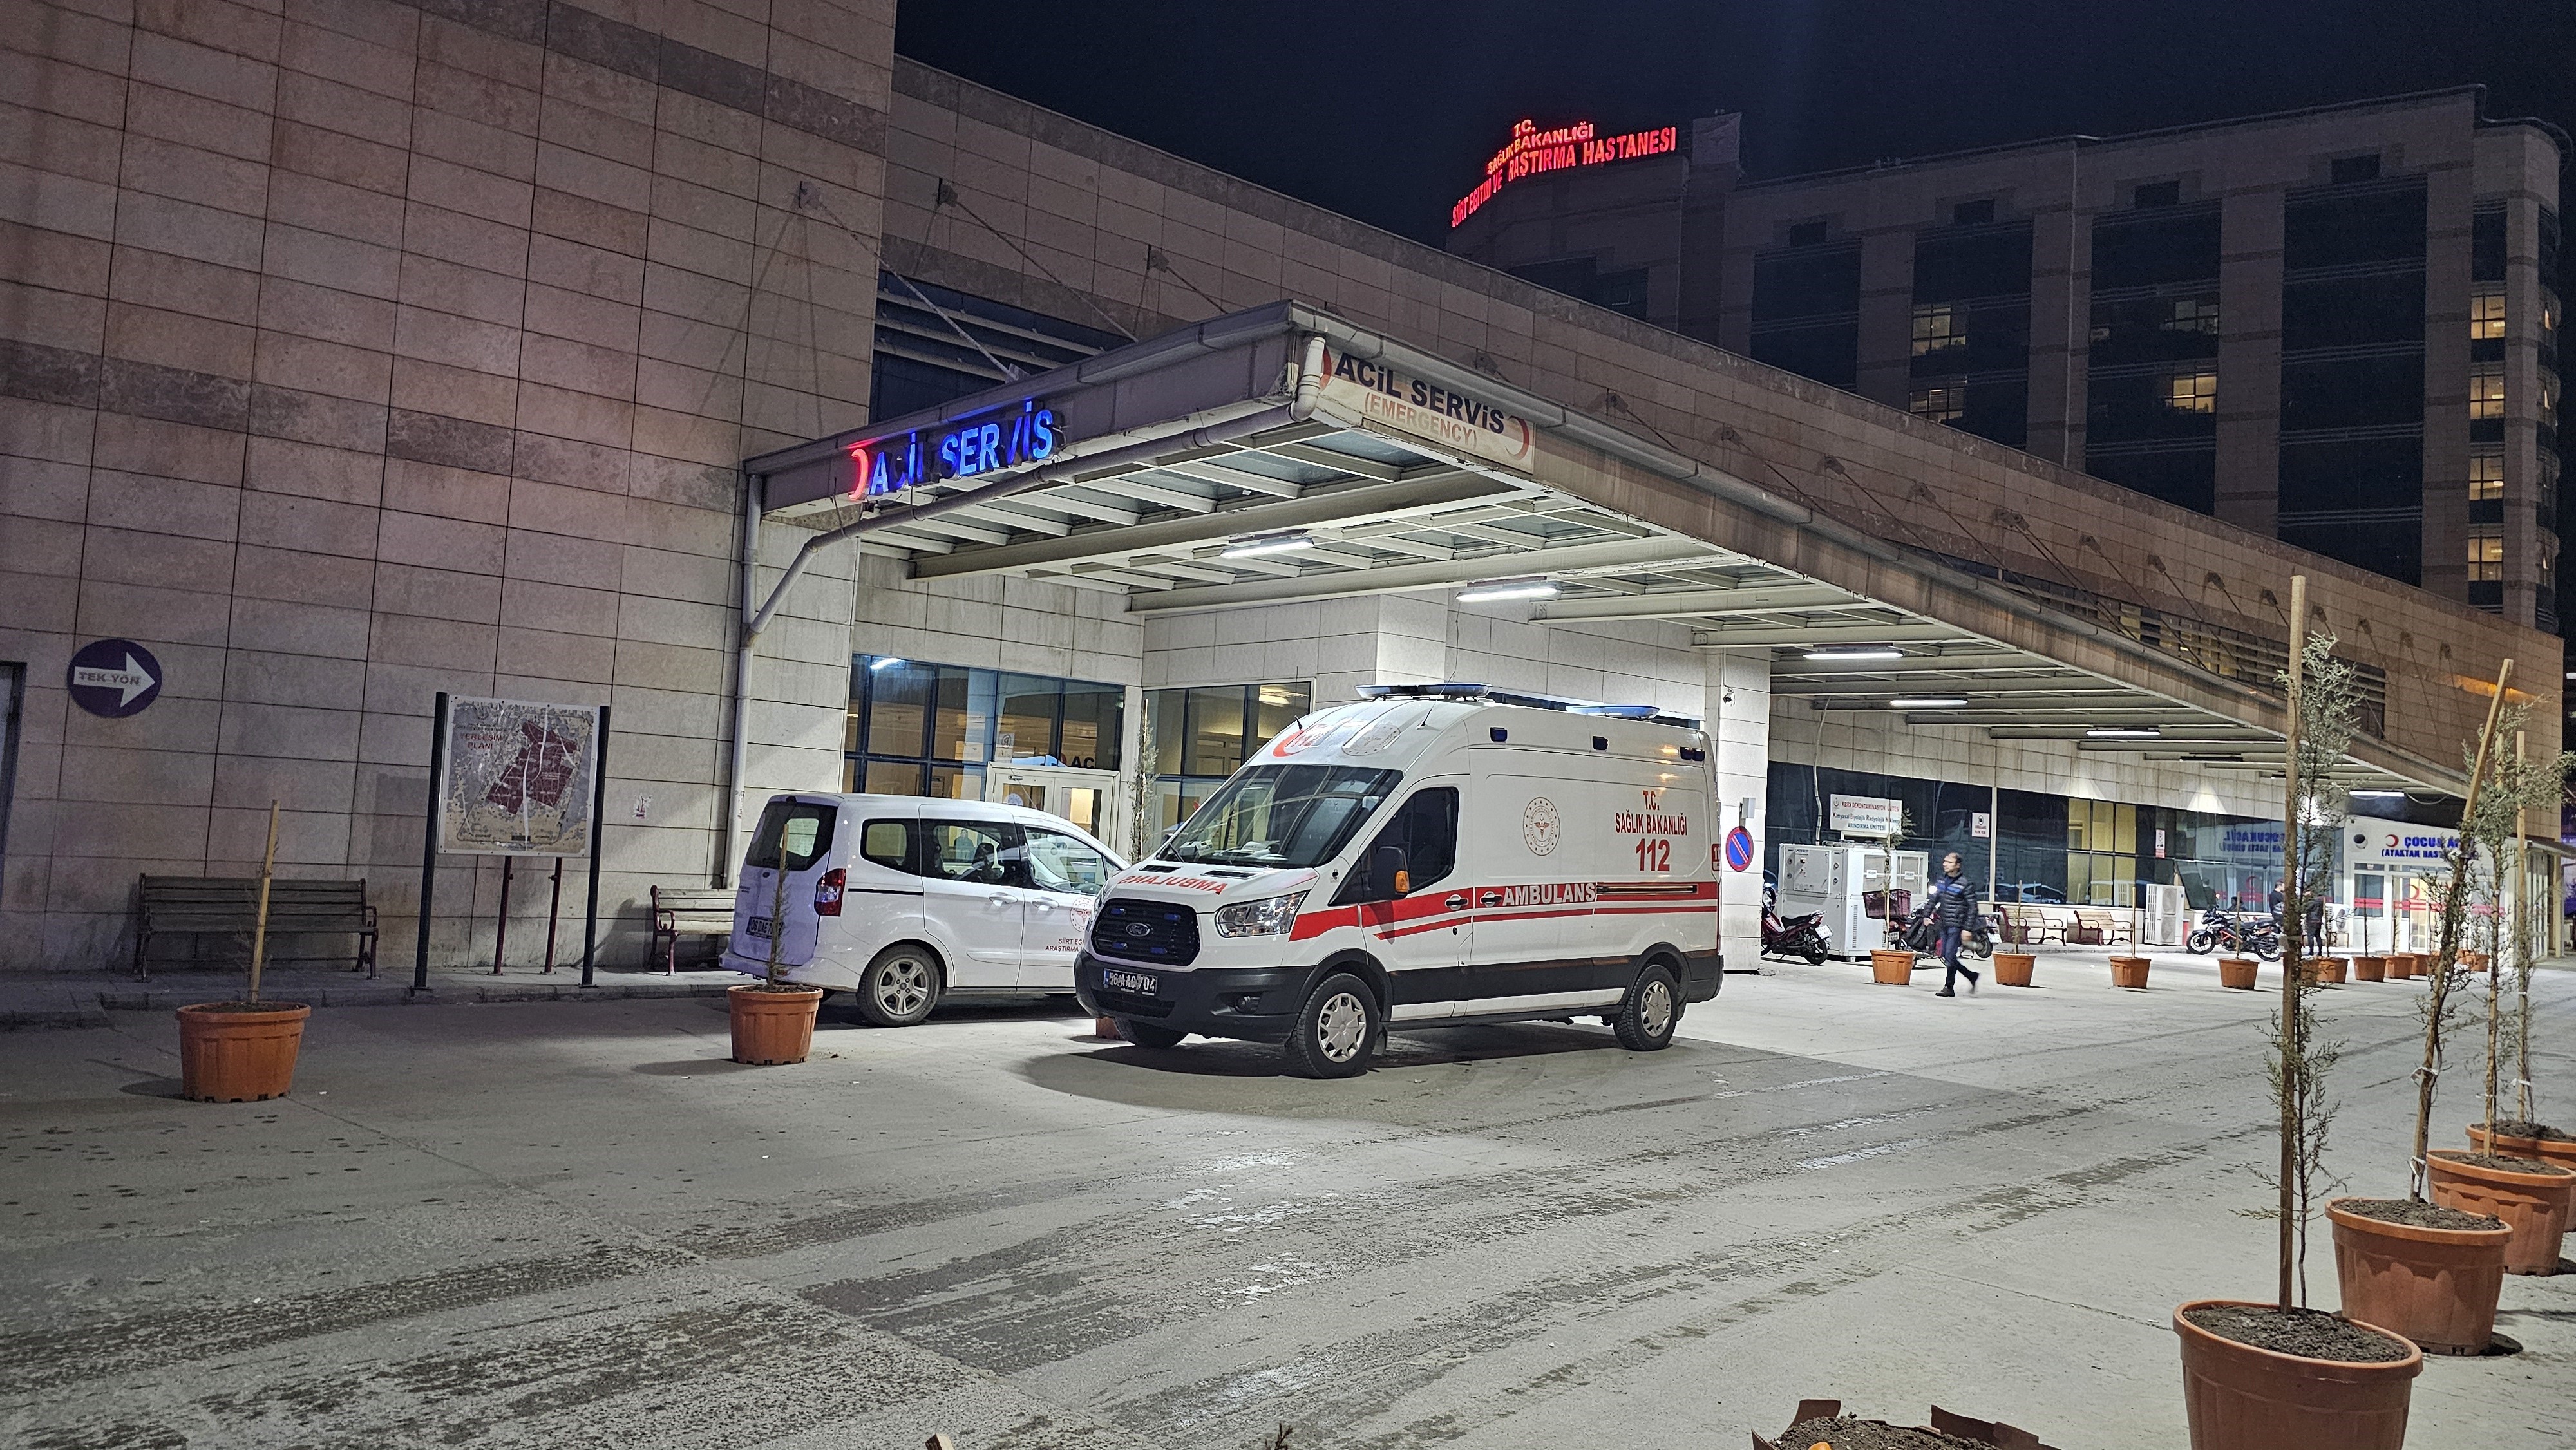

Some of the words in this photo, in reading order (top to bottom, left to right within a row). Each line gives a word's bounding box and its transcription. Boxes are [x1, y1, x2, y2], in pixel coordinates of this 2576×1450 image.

[1514, 119, 1536, 137] T.C.
[1487, 149, 1515, 175] SAĞLIK
[1514, 121, 1594, 153] BAKANLIĞI
[1492, 169, 1503, 194] VE
[1365, 391, 1477, 449] (EMERGENCY)
[940, 400, 1053, 480] SERVİS
[79, 672, 108, 683] TEK
[111, 673, 140, 686] YÖN
[1642, 790, 1660, 811] T.C.
[1615, 809, 1645, 834] SAĞLIK
[1646, 812, 1688, 836] BAKANLIĞI
[1636, 838, 1671, 872] 112
[1502, 883, 1596, 907] AMBULANS
[1129, 925, 1143, 934] Ford
